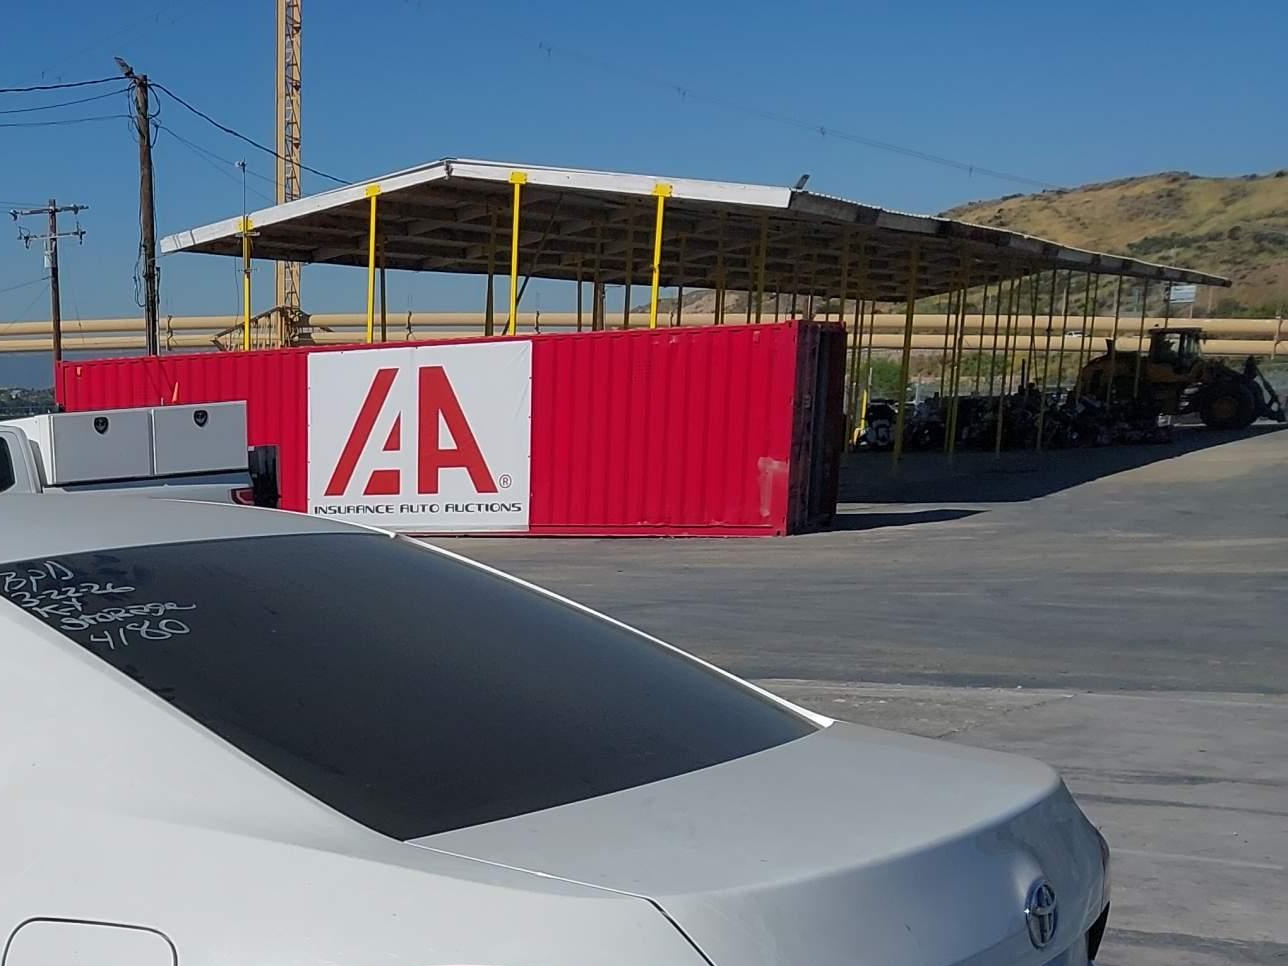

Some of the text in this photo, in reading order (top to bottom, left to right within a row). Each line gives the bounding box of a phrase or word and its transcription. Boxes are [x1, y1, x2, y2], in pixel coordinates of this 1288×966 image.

[314, 502, 522, 515] INSURANCE AUTO AUCTIONS
